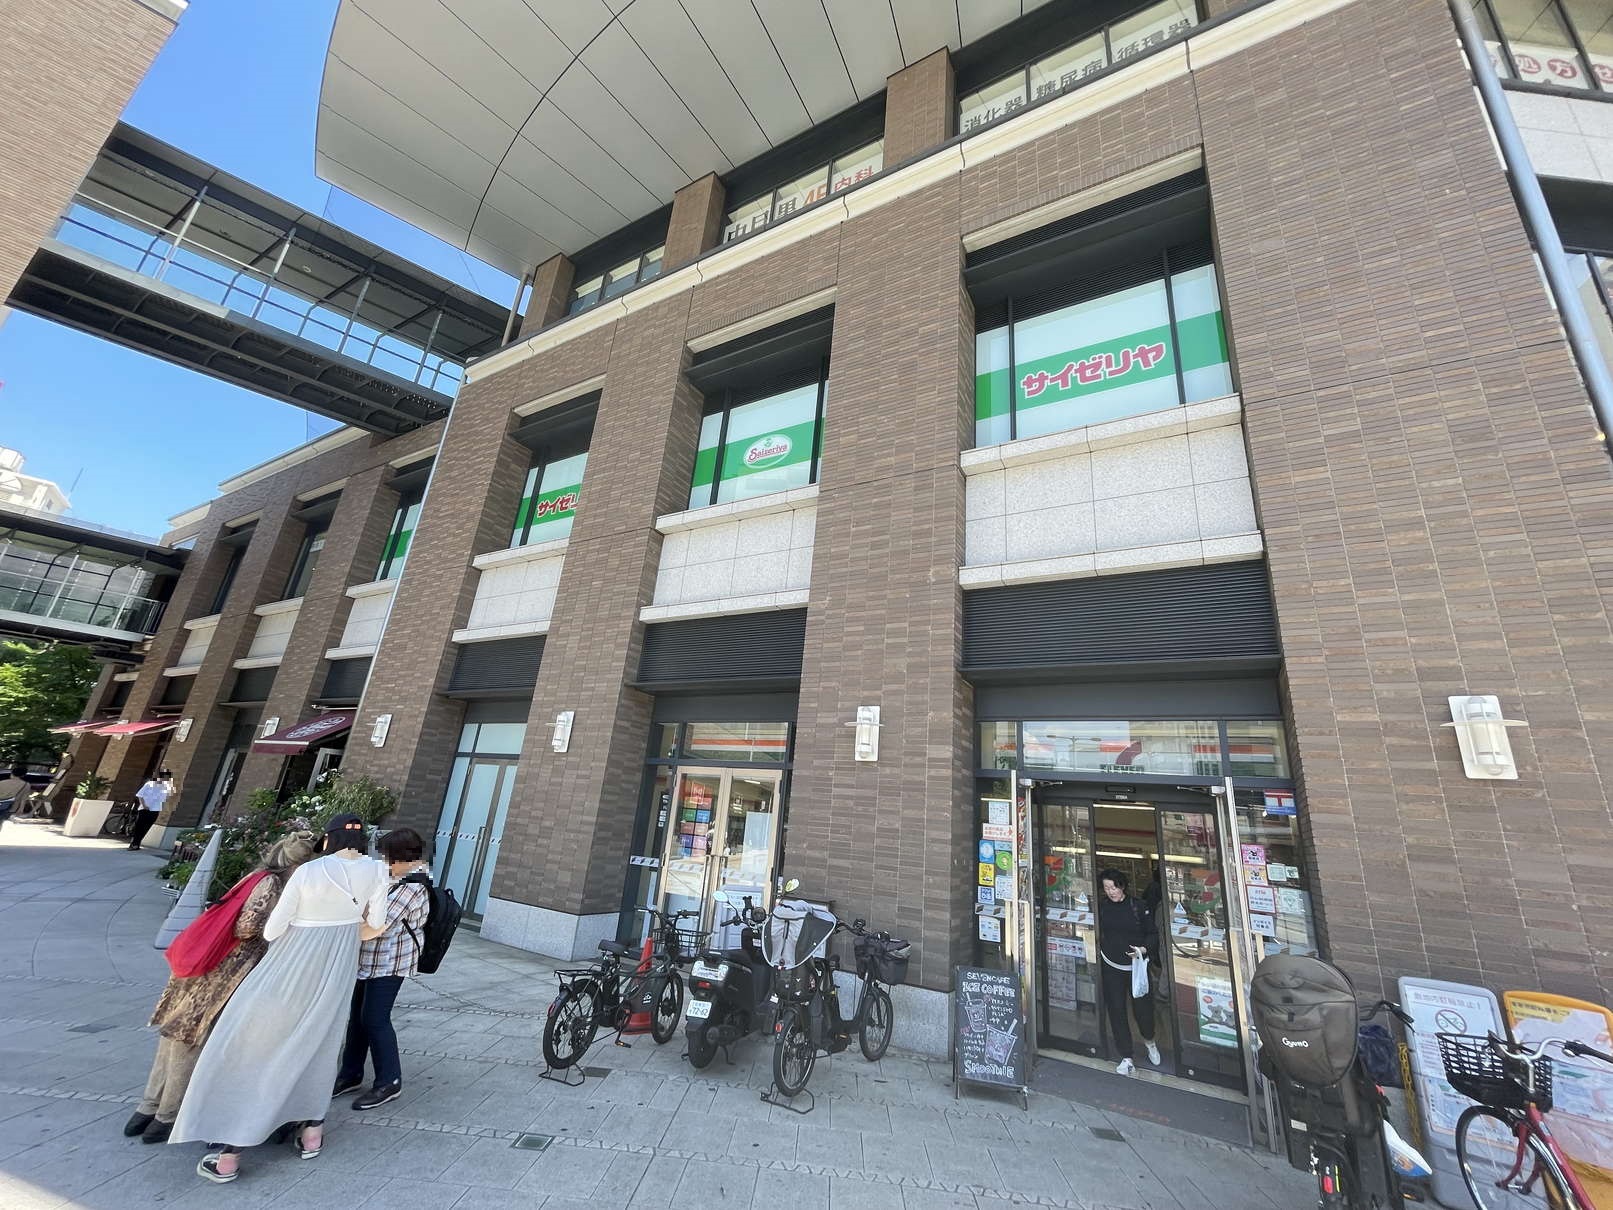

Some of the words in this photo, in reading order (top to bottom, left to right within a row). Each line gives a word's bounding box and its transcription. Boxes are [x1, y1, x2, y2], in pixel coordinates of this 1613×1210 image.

[1036, 58, 1103, 98] 糖尿病
[834, 165, 874, 192] 内科
[1021, 343, 1165, 398] サイゼリヤ
[980, 983, 1016, 998] COFFEE
[964, 1059, 1016, 1079] SMOOTHIE
